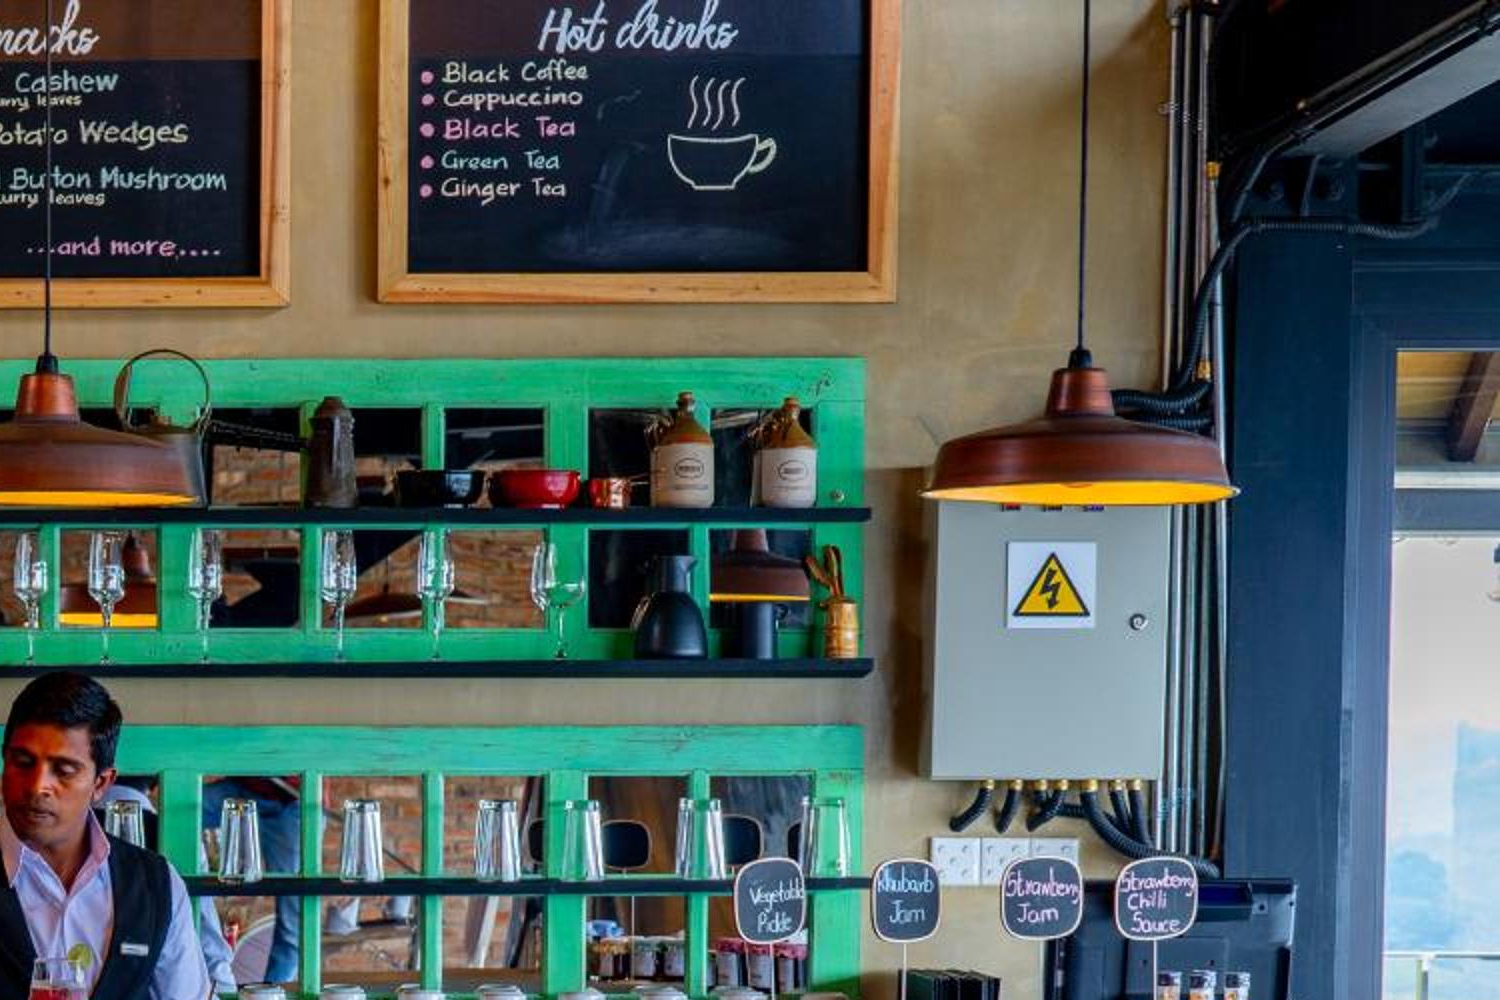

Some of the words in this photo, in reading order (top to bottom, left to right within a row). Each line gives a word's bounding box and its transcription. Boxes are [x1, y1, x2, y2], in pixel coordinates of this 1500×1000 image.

[537, 0, 609, 54] Hot
[615, 0, 739, 51] drinks
[14, 69, 119, 94] Cashew
[441, 61, 510, 84] Black
[521, 58, 589, 82] Coffee
[443, 86, 584, 112] Cappuccino
[79, 118, 190, 151] Wedges
[443, 116, 521, 140] Black
[535, 115, 576, 137] Tea
[441, 150, 509, 170] Green
[524, 149, 561, 170] Tea
[8, 164, 93, 192] Buton
[100, 164, 228, 192] Mushroom
[48, 187, 106, 207] leaves
[440, 177, 522, 207] Ginger
[531, 177, 567, 197] Tea
[1004, 866, 1080, 905] Strawberry
[1119, 867, 1197, 897] Strawberry
[888, 899, 927, 925] Jam
[1016, 902, 1061, 924] Jam
[1126, 893, 1168, 911] Chilli
[1130, 911, 1182, 934] Sauce
